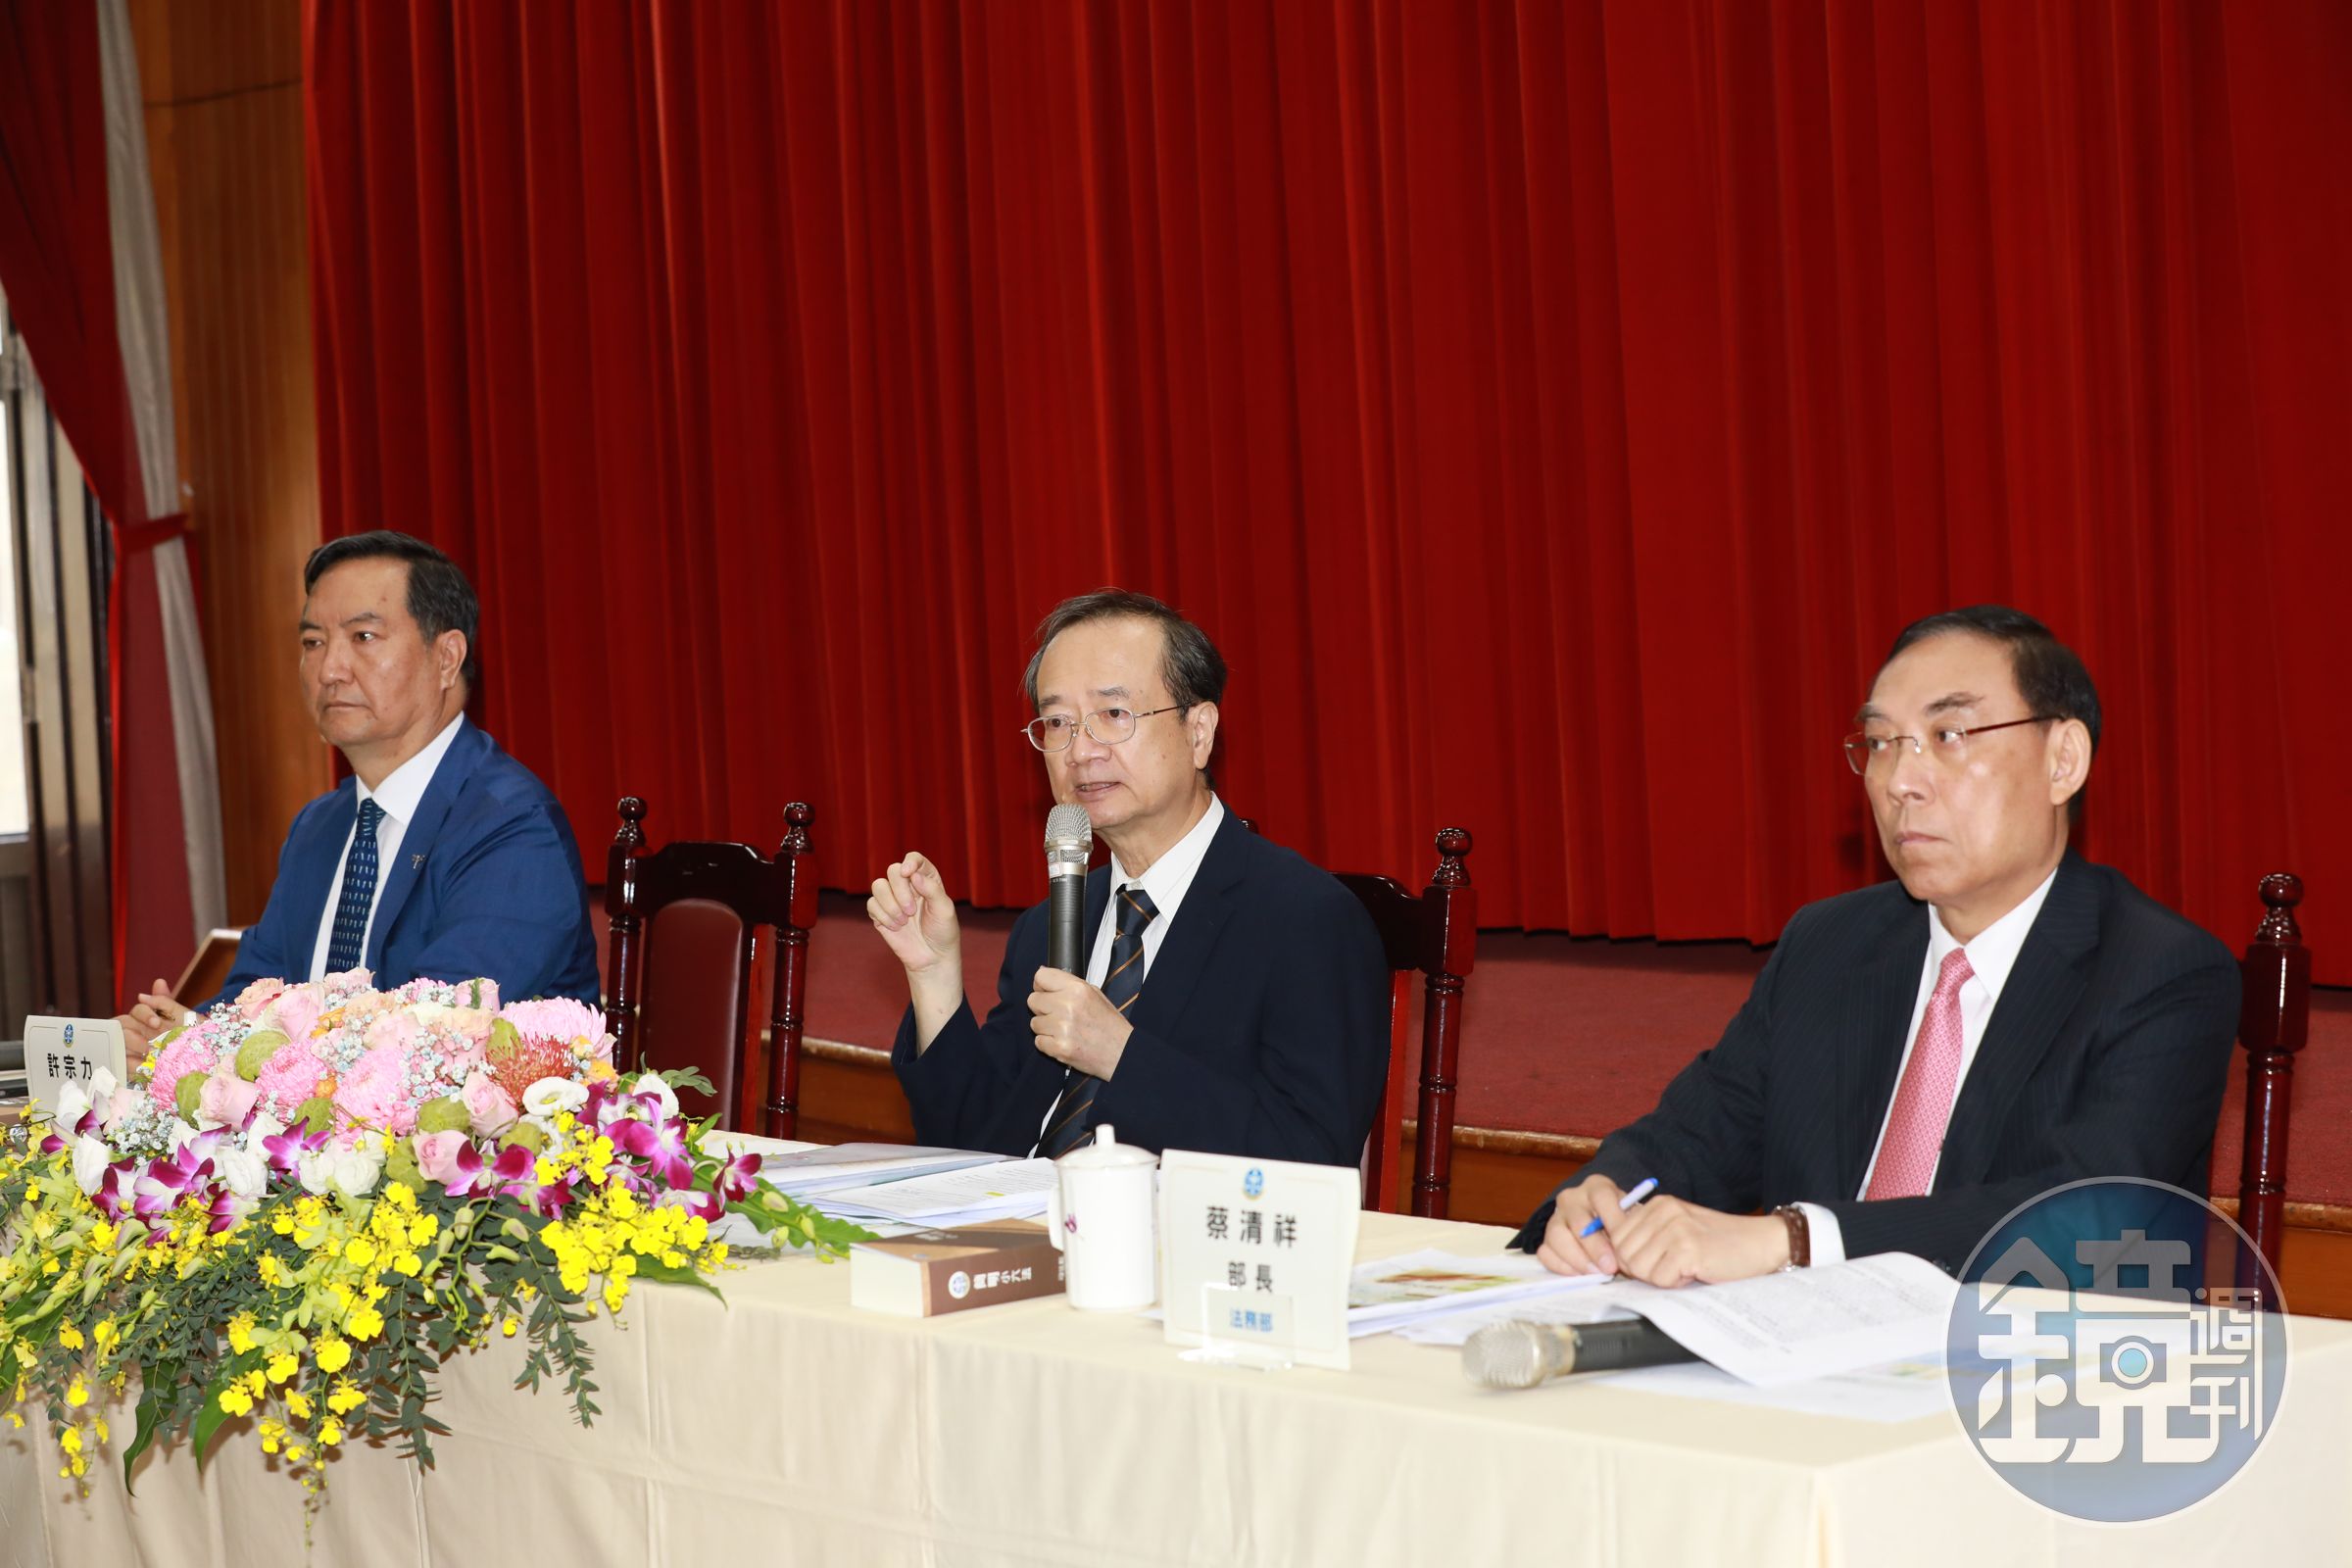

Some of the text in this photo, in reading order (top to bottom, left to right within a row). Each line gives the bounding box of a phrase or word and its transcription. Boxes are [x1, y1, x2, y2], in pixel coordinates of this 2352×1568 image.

[46, 1053, 93, 1080] 許宗力
[1206, 1205, 1298, 1249] 蔡清祥
[1228, 1261, 1273, 1293] 部長
[1229, 1308, 1274, 1333] 法務部
